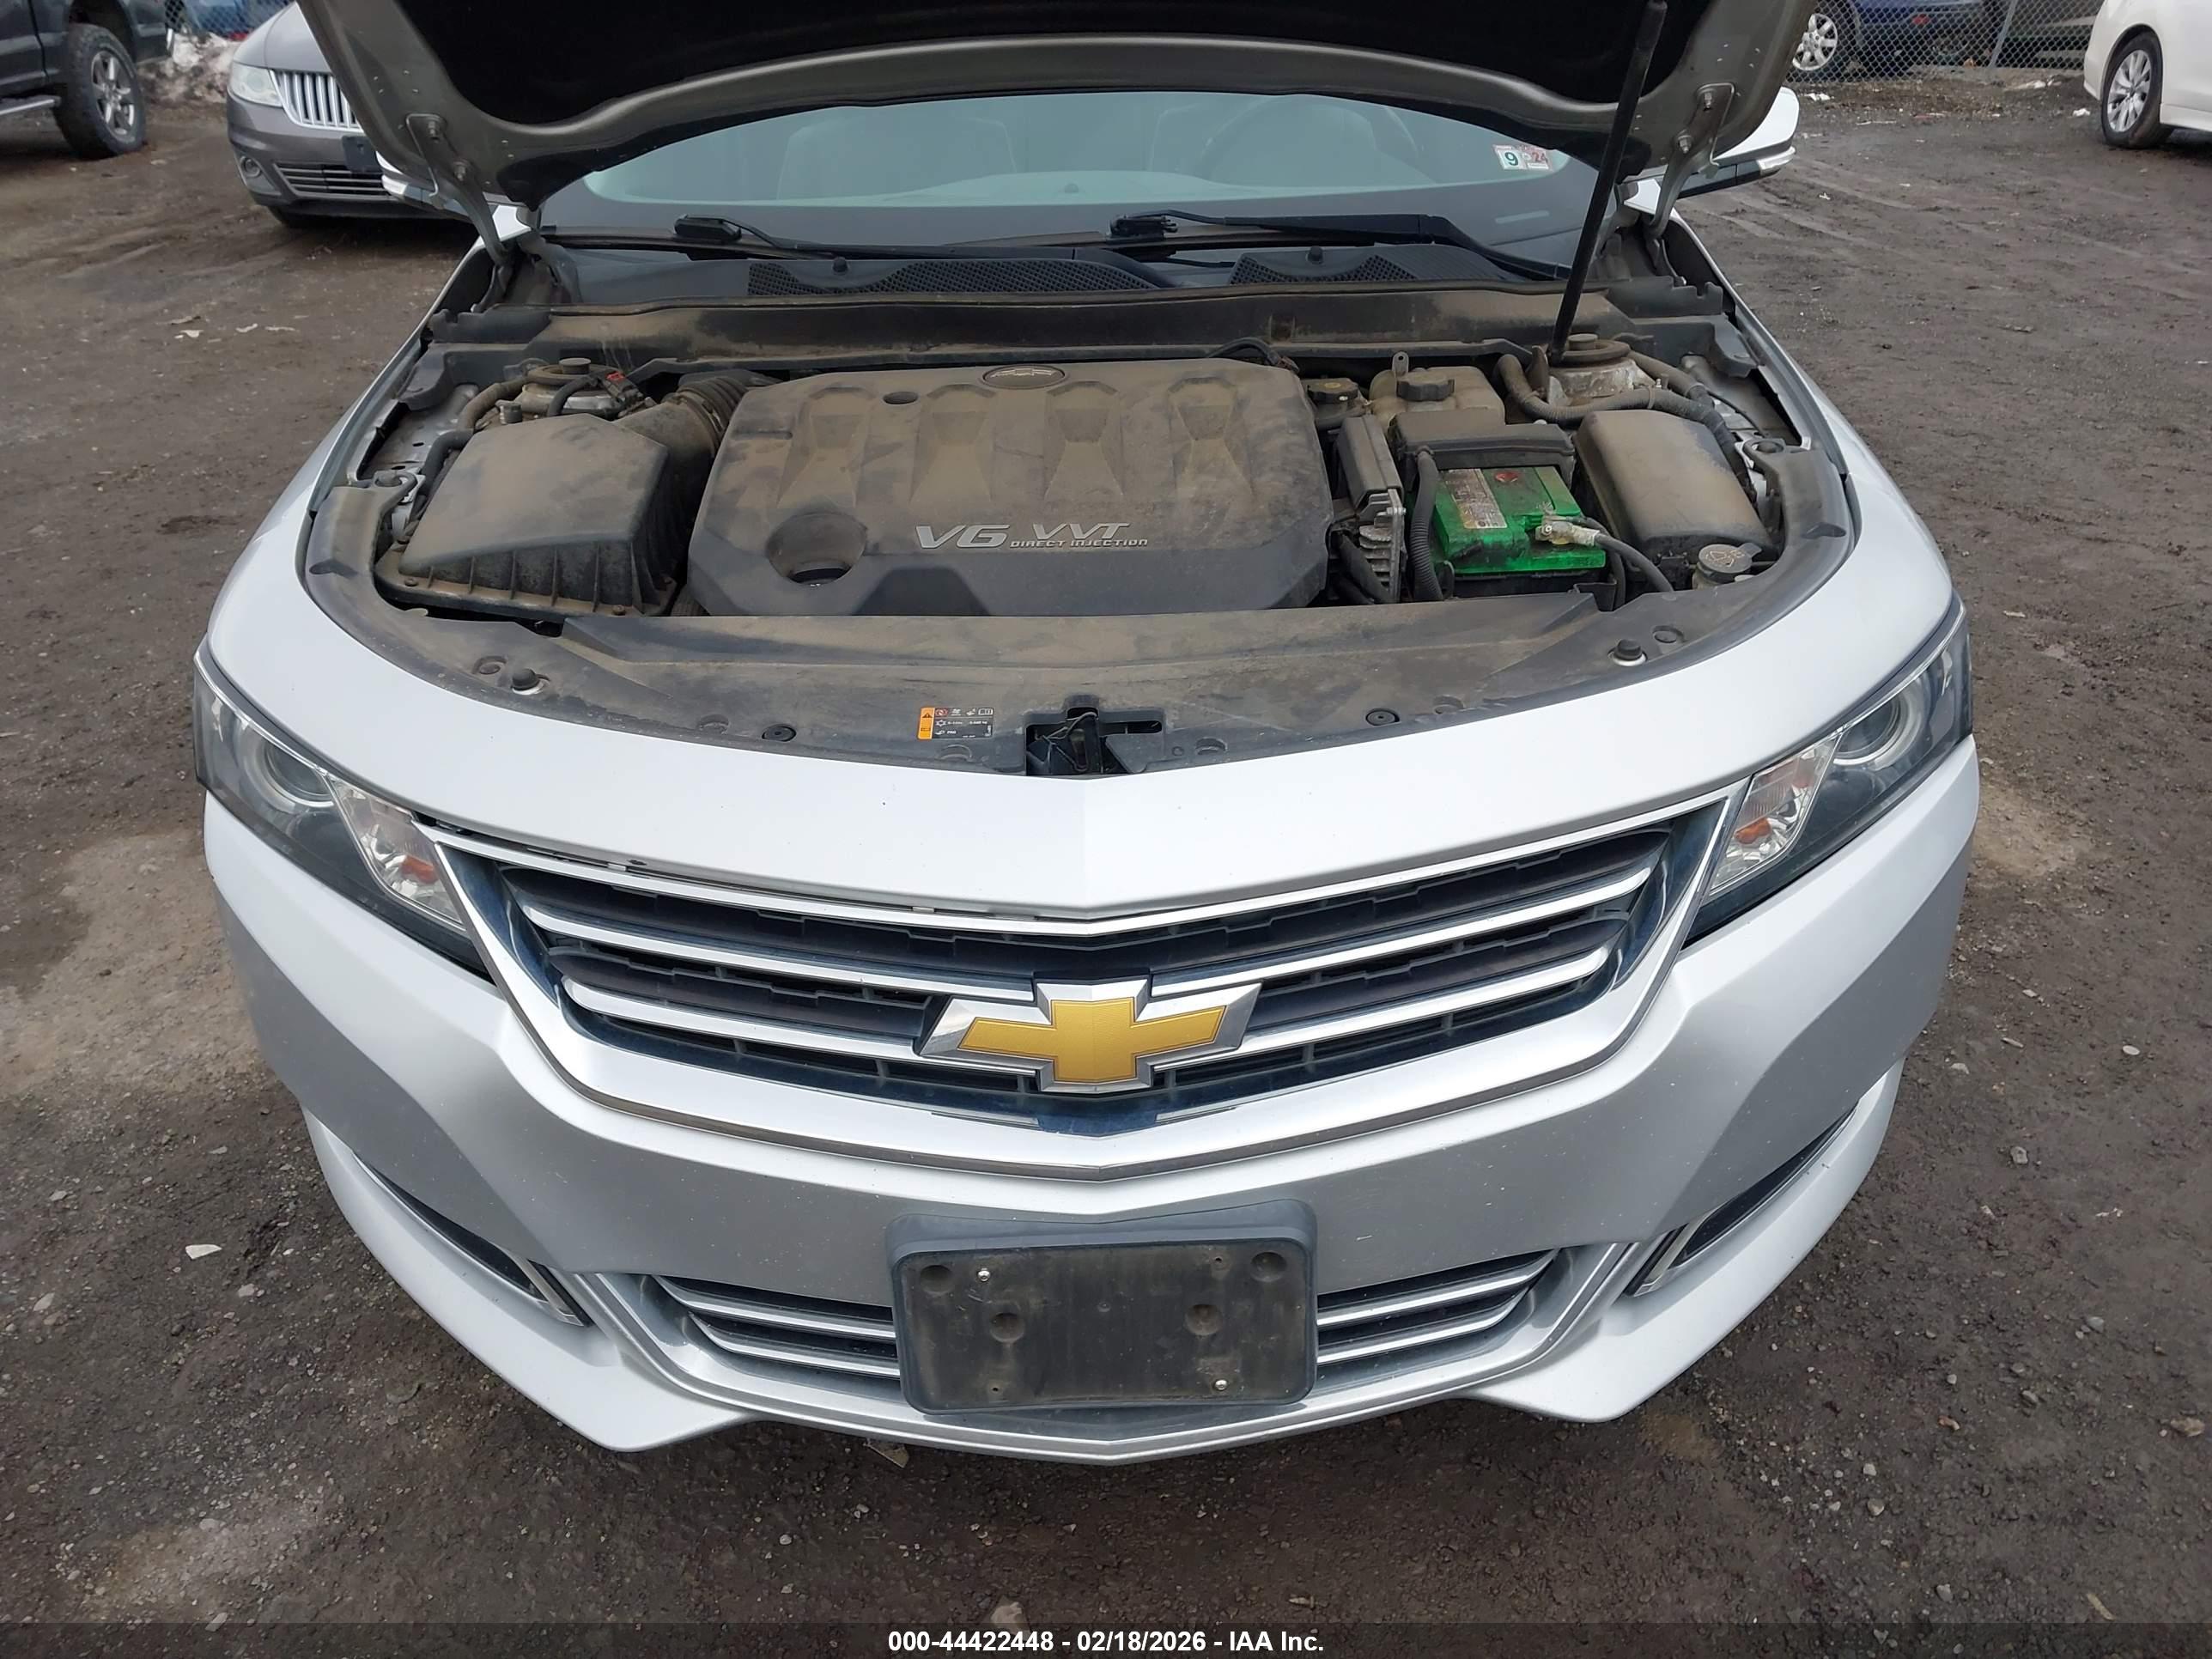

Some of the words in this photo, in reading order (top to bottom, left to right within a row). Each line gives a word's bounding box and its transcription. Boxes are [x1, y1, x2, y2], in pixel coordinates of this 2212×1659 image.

[1504, 151, 1519, 166] 9
[915, 524, 1011, 549] V6
[1032, 522, 1130, 539] VVT
[1010, 539, 1065, 548] DIRECT
[1070, 538, 1148, 548] INJECTION
